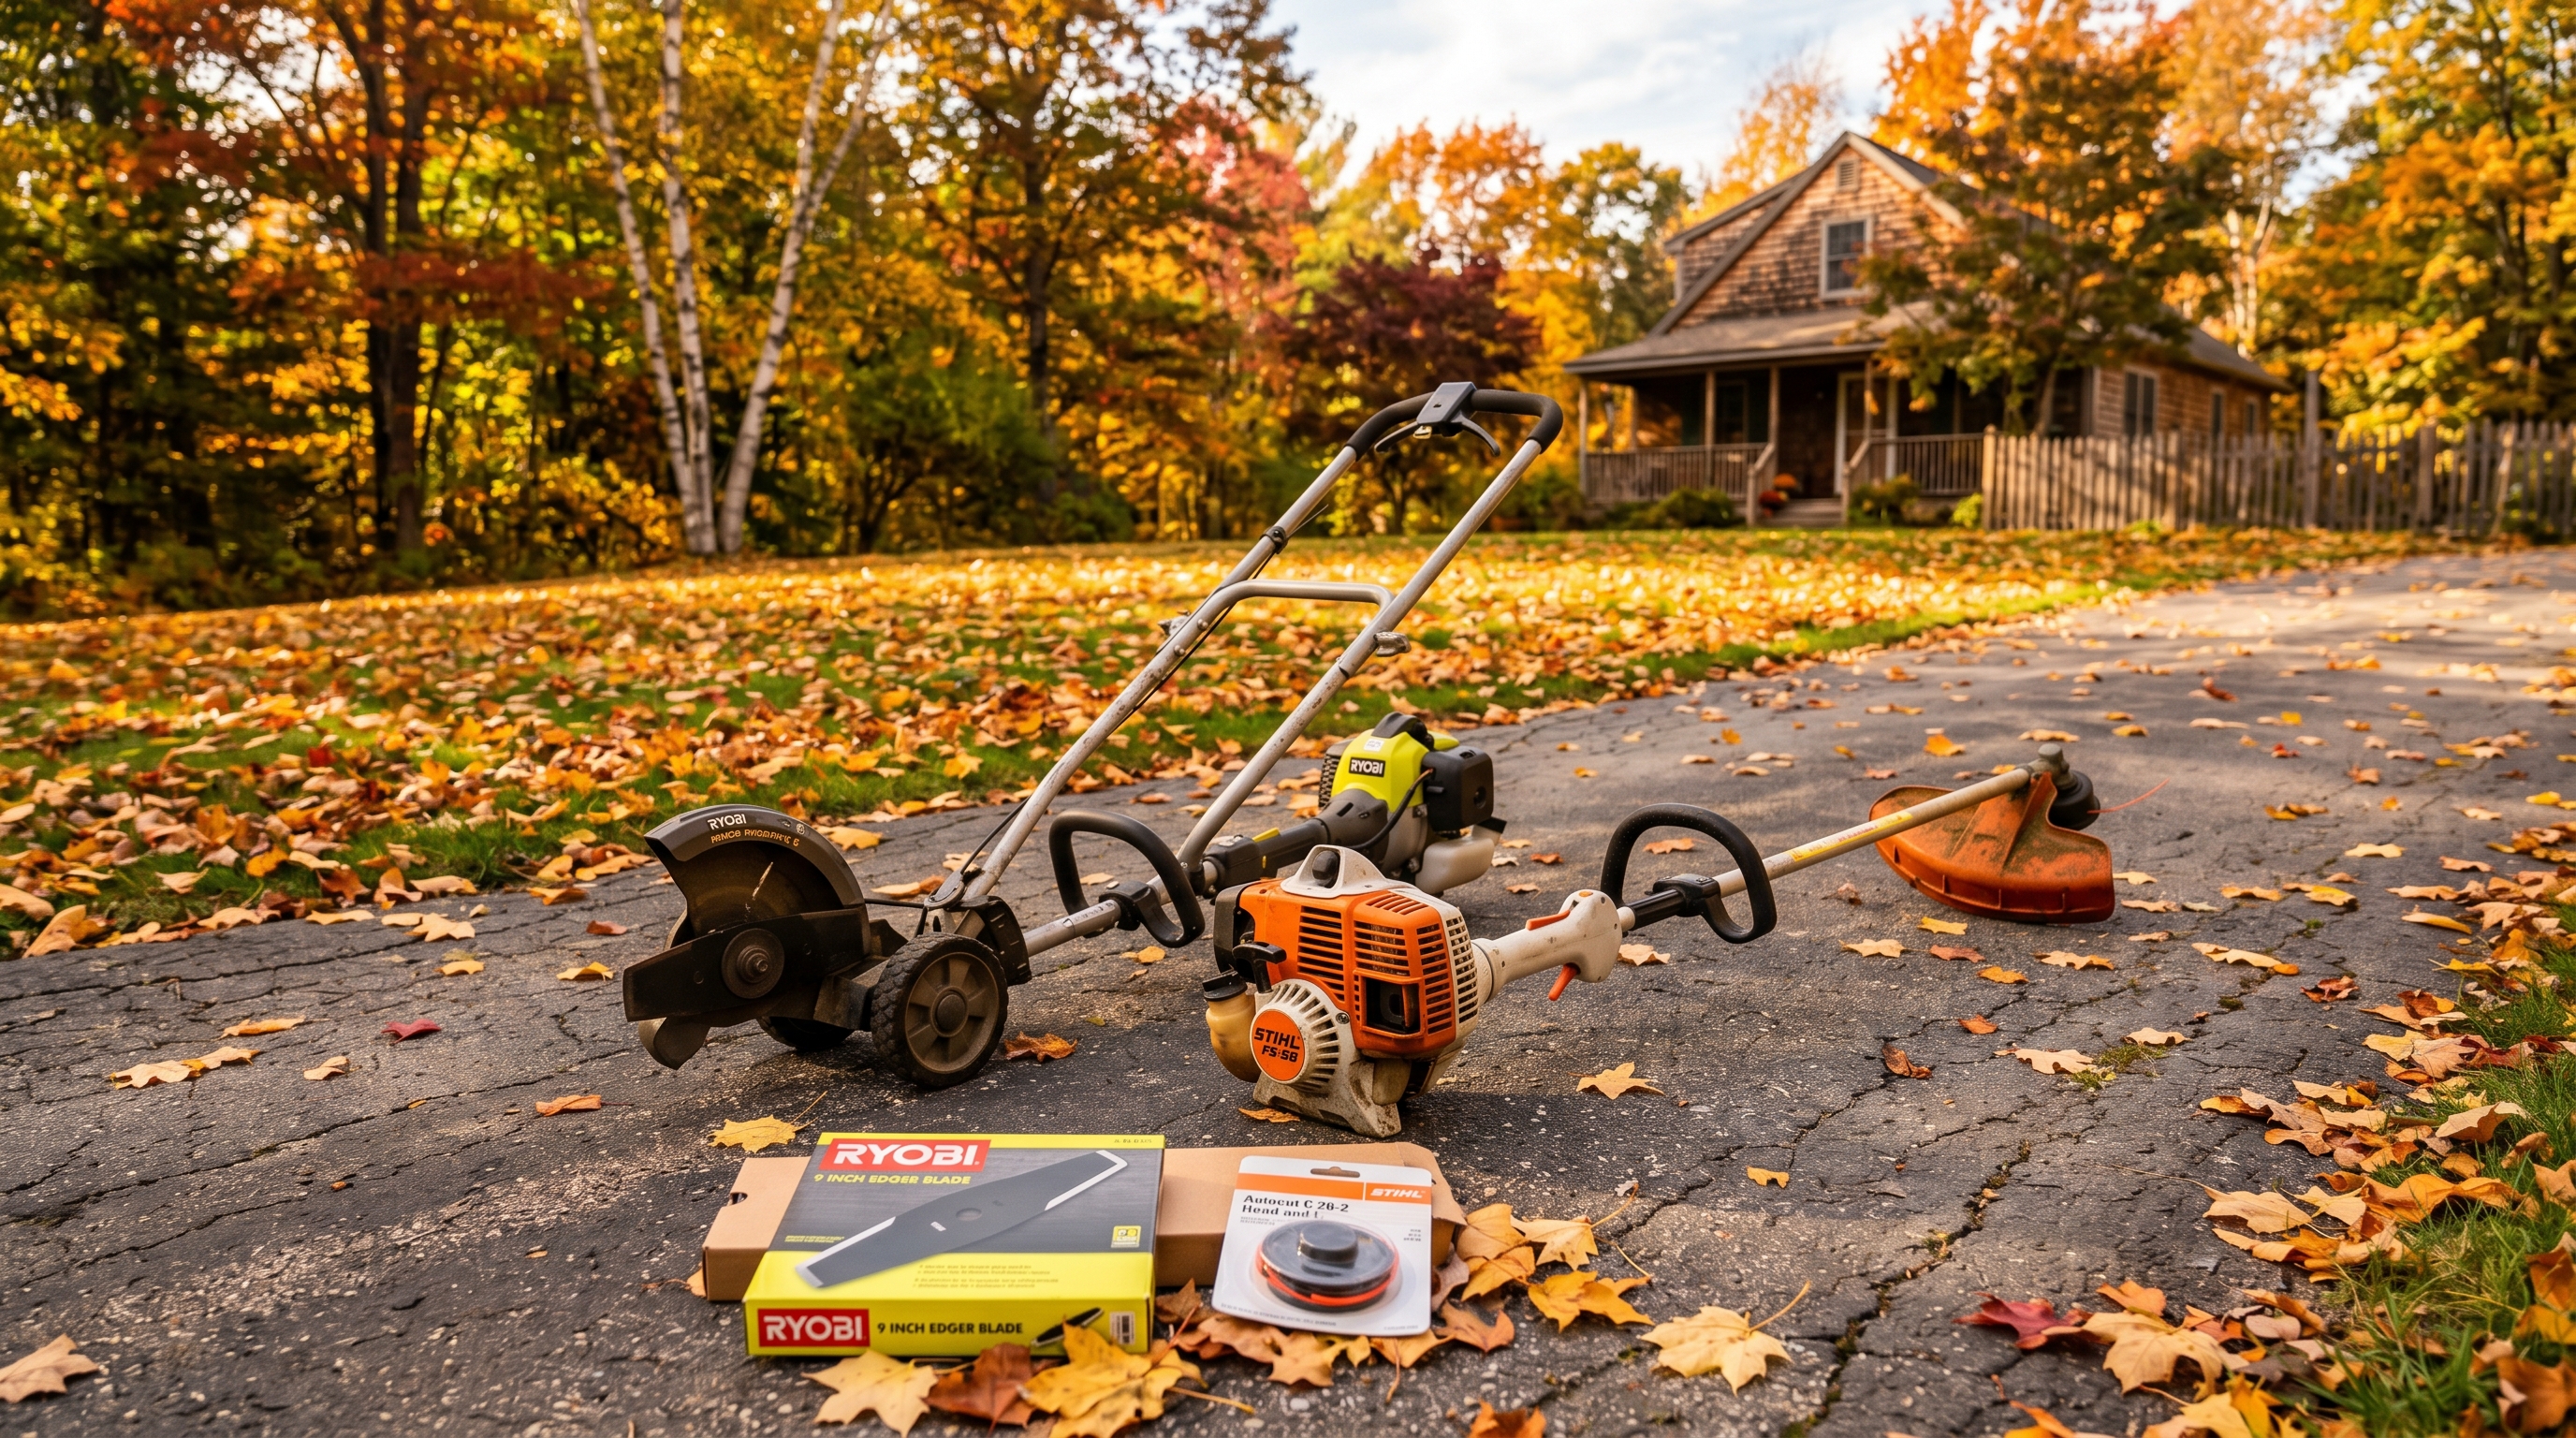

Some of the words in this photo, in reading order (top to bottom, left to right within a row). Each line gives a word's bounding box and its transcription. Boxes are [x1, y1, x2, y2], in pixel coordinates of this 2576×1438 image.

[1351, 759, 1383, 774] RYOBI
[707, 814, 747, 830] RYOBI
[1254, 1027, 1300, 1049] STIHL
[833, 1143, 978, 1166] RYOBI
[813, 1174, 825, 1182] 9
[827, 1174, 866, 1183] INCH
[868, 1175, 919, 1184] EDGER
[922, 1176, 972, 1184] BLADE
[1370, 1188, 1423, 1198] STIHL
[1243, 1195, 1299, 1208] Autocut
[1304, 1199, 1313, 1209] C
[1283, 1210, 1310, 1218] and
[763, 1315, 862, 1341] RYOBI
[877, 1323, 886, 1333] 9
[890, 1323, 926, 1334] INCH
[929, 1323, 975, 1334] EDGER
[979, 1323, 1023, 1334] BLADE
